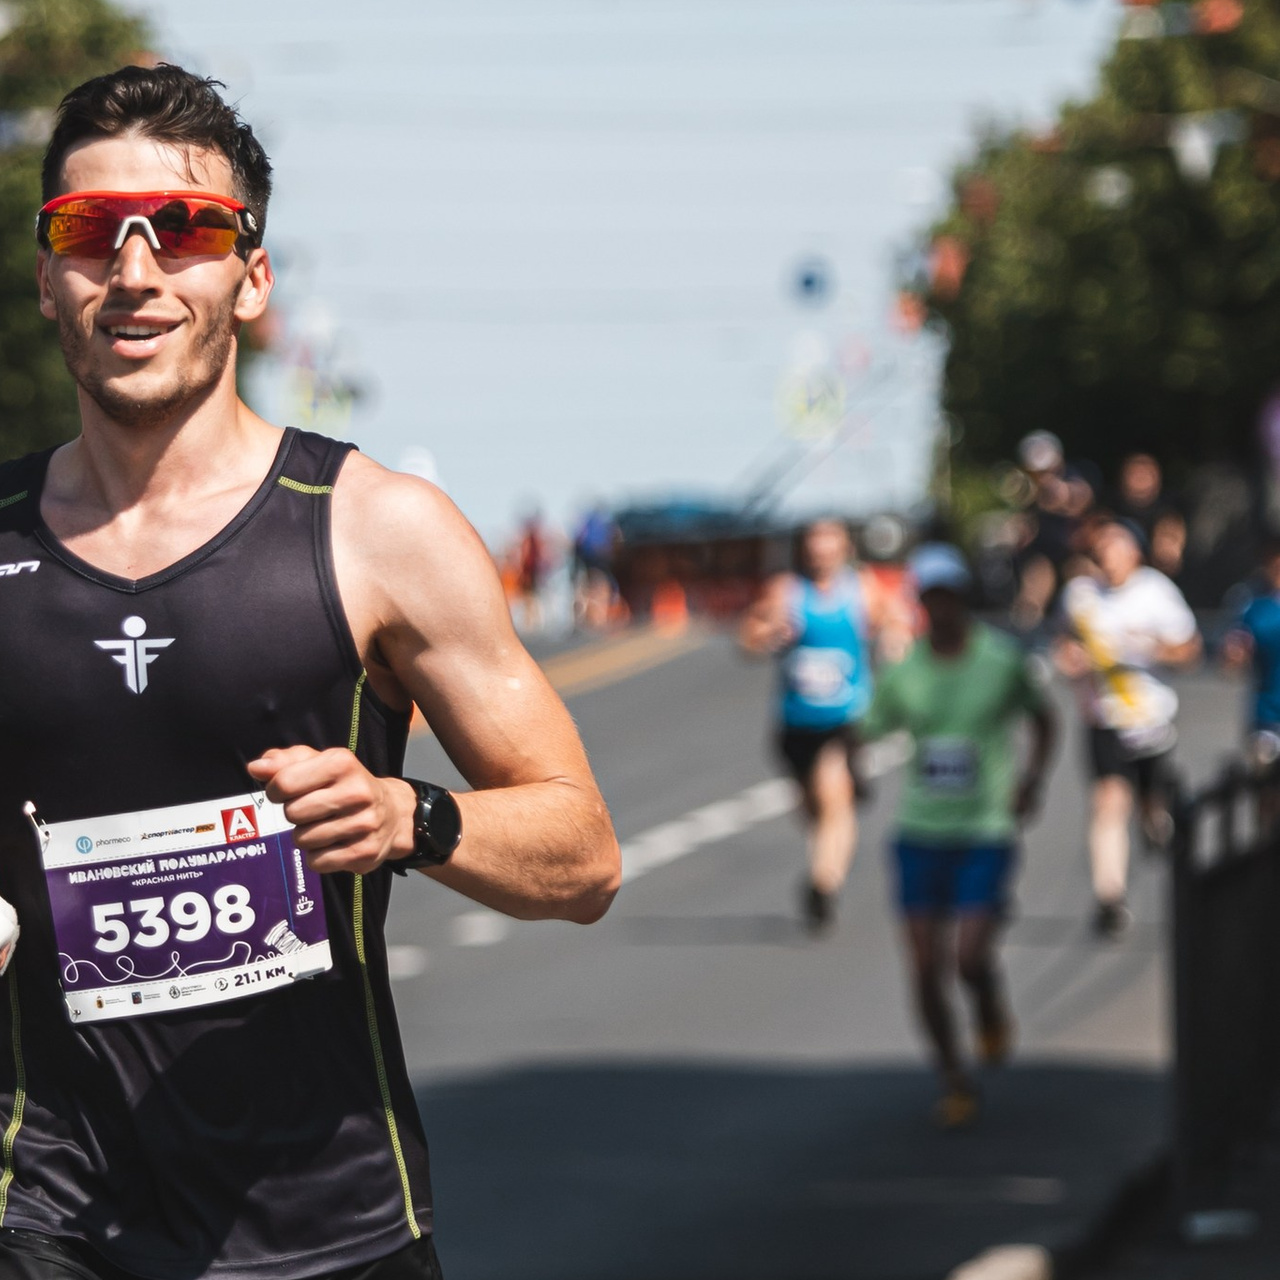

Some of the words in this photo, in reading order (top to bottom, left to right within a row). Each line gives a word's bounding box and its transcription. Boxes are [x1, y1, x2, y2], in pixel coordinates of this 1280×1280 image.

[96, 836, 131, 848] pharmeco
[230, 832, 257, 841] КЛАСТЕР
[69, 859, 155, 884] ИВАНОВСКИЙ
[159, 842, 267, 871] ПОЛУМАРАФОН
[293, 848, 306, 893] Иваново
[132, 873, 175, 887] «КРАСНАЯ
[176, 871, 204, 881] НИТЬ»
[93, 884, 256, 953] 5398
[234, 970, 262, 987] 21.1
